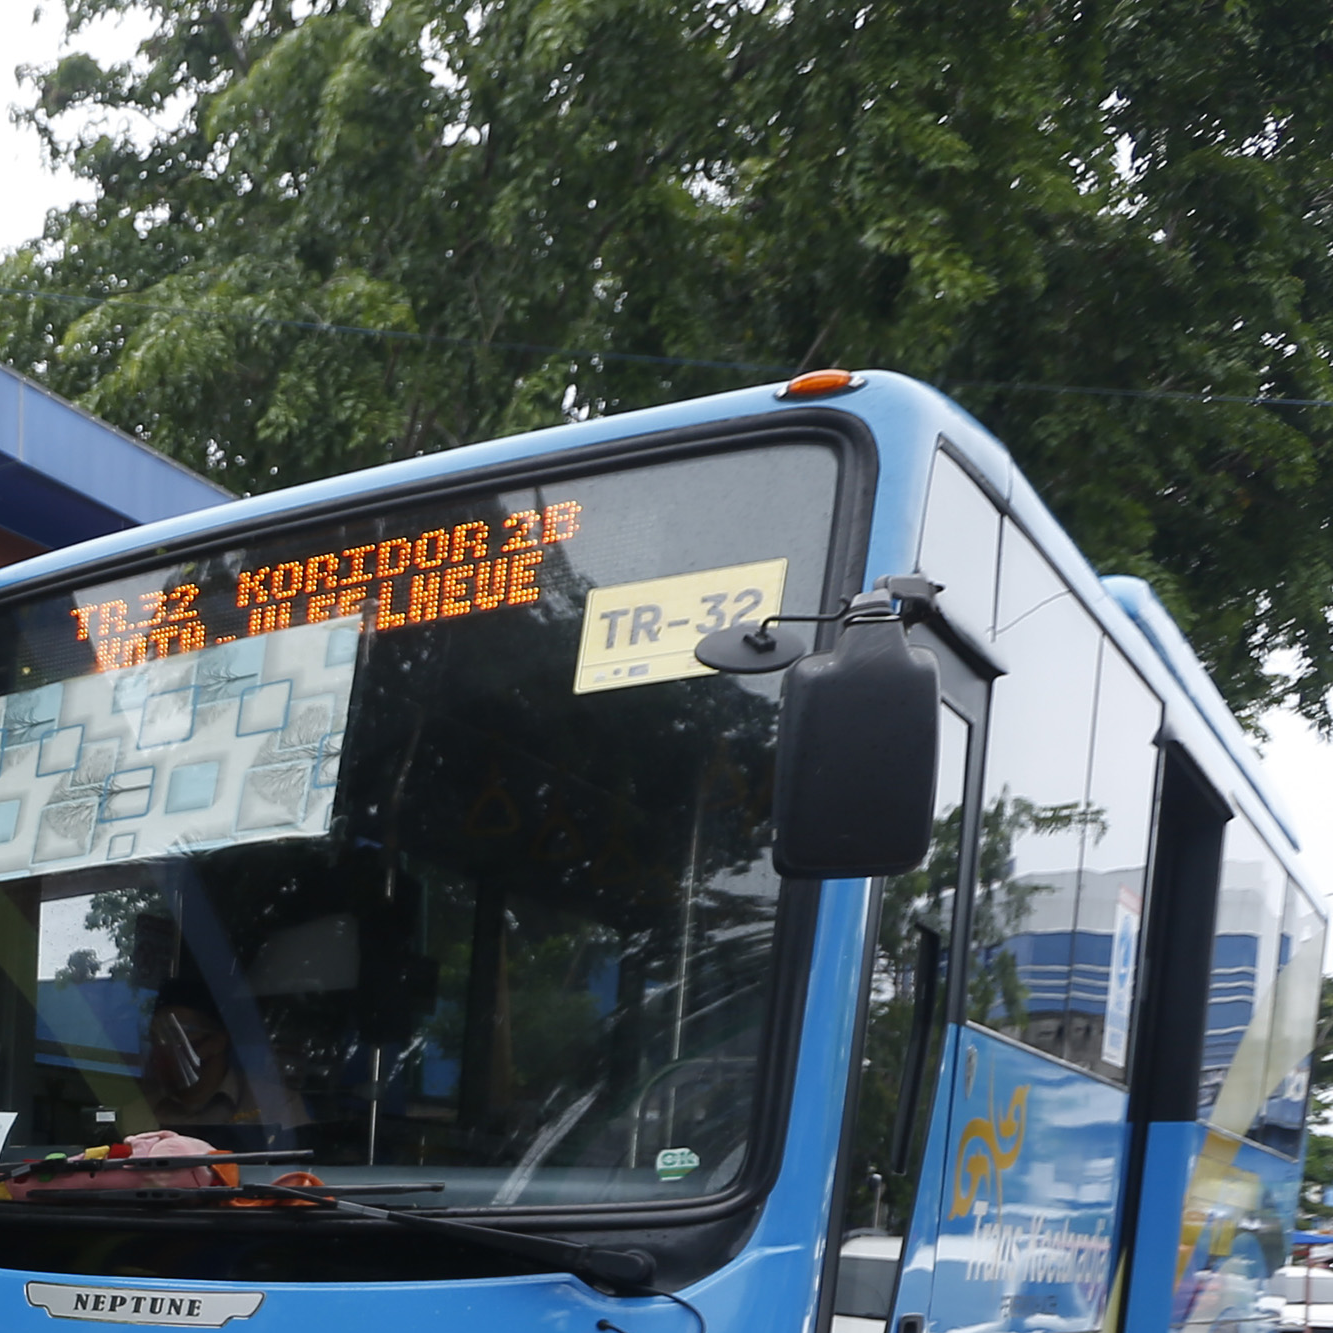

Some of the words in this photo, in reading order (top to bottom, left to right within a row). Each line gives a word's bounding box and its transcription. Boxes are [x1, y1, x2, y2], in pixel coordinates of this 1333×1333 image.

[236, 520, 489, 607] KORIDOR
[501, 500, 582, 552] 2B
[600, 588, 764, 649] TR-32
[73, 1292, 204, 1317] NEPTUNE
